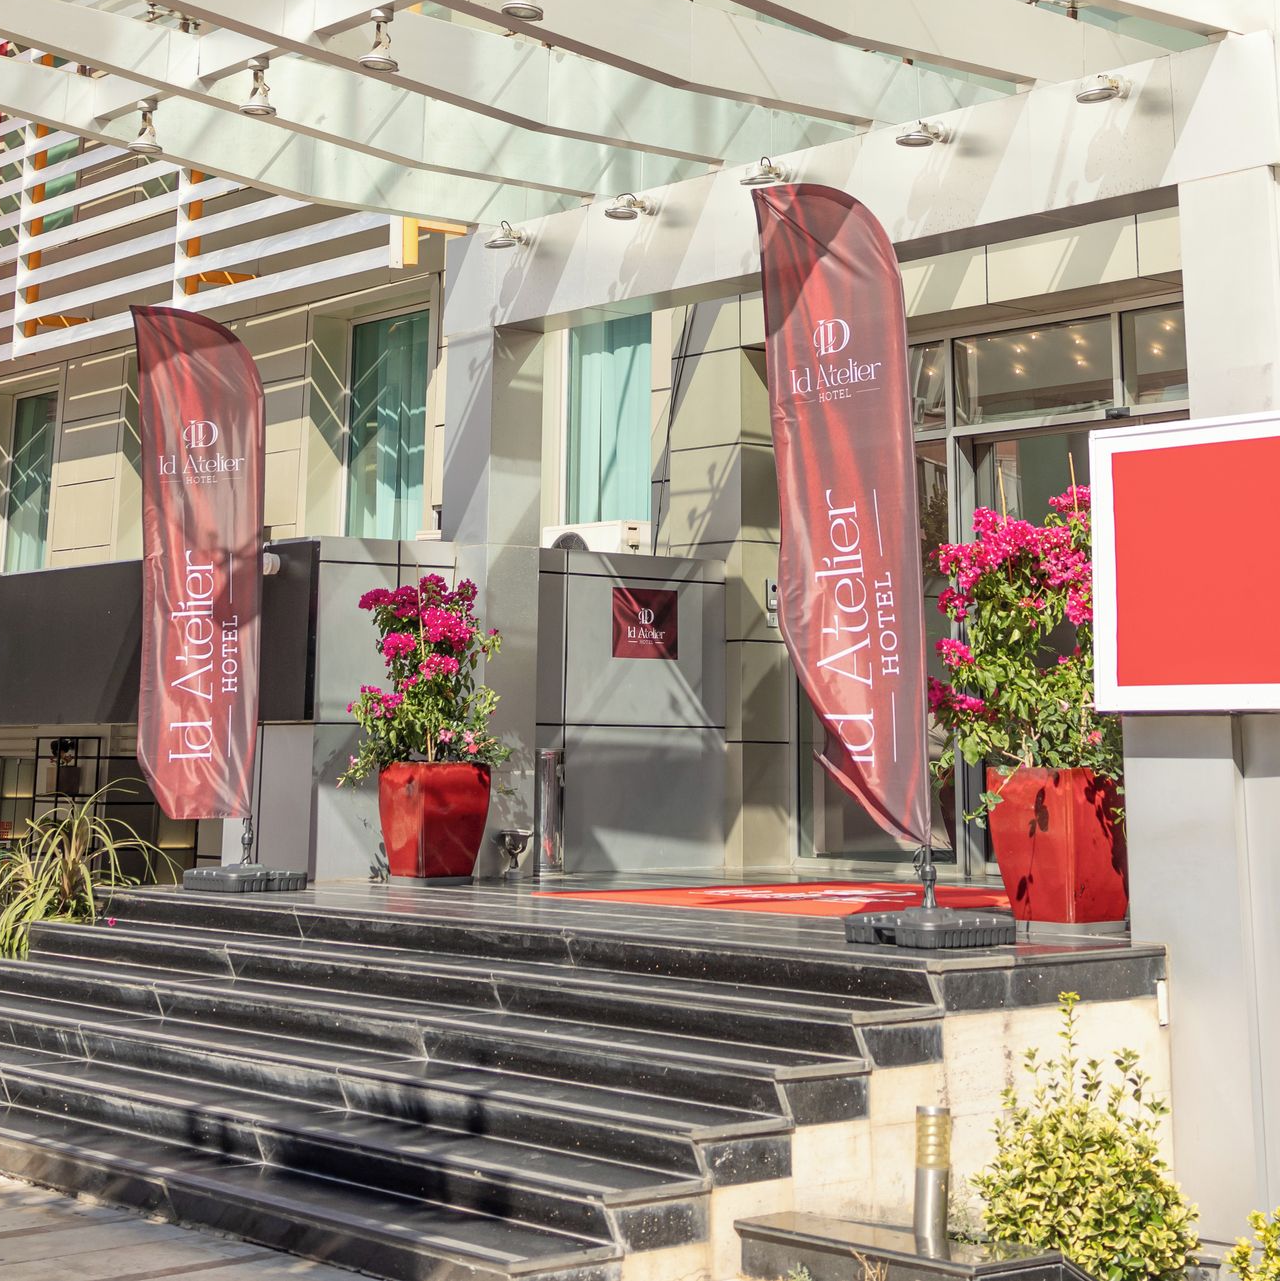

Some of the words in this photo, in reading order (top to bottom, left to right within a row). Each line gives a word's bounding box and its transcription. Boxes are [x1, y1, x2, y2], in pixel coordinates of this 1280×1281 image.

[790, 367, 812, 394] Id
[816, 358, 881, 389] Atelier
[818, 388, 852, 403] HOTEL
[159, 454, 177, 475] Id
[182, 452, 245, 475] Atelier
[185, 475, 218, 485] HOTEL
[814, 488, 873, 689] Atelier
[171, 550, 214, 703] Atelier
[627, 626, 635, 638] Id
[638, 626, 665, 639] Atelier
[874, 571, 900, 675] HOTEL
[221, 615, 238, 693] HOTEL
[168, 717, 213, 763] Id
